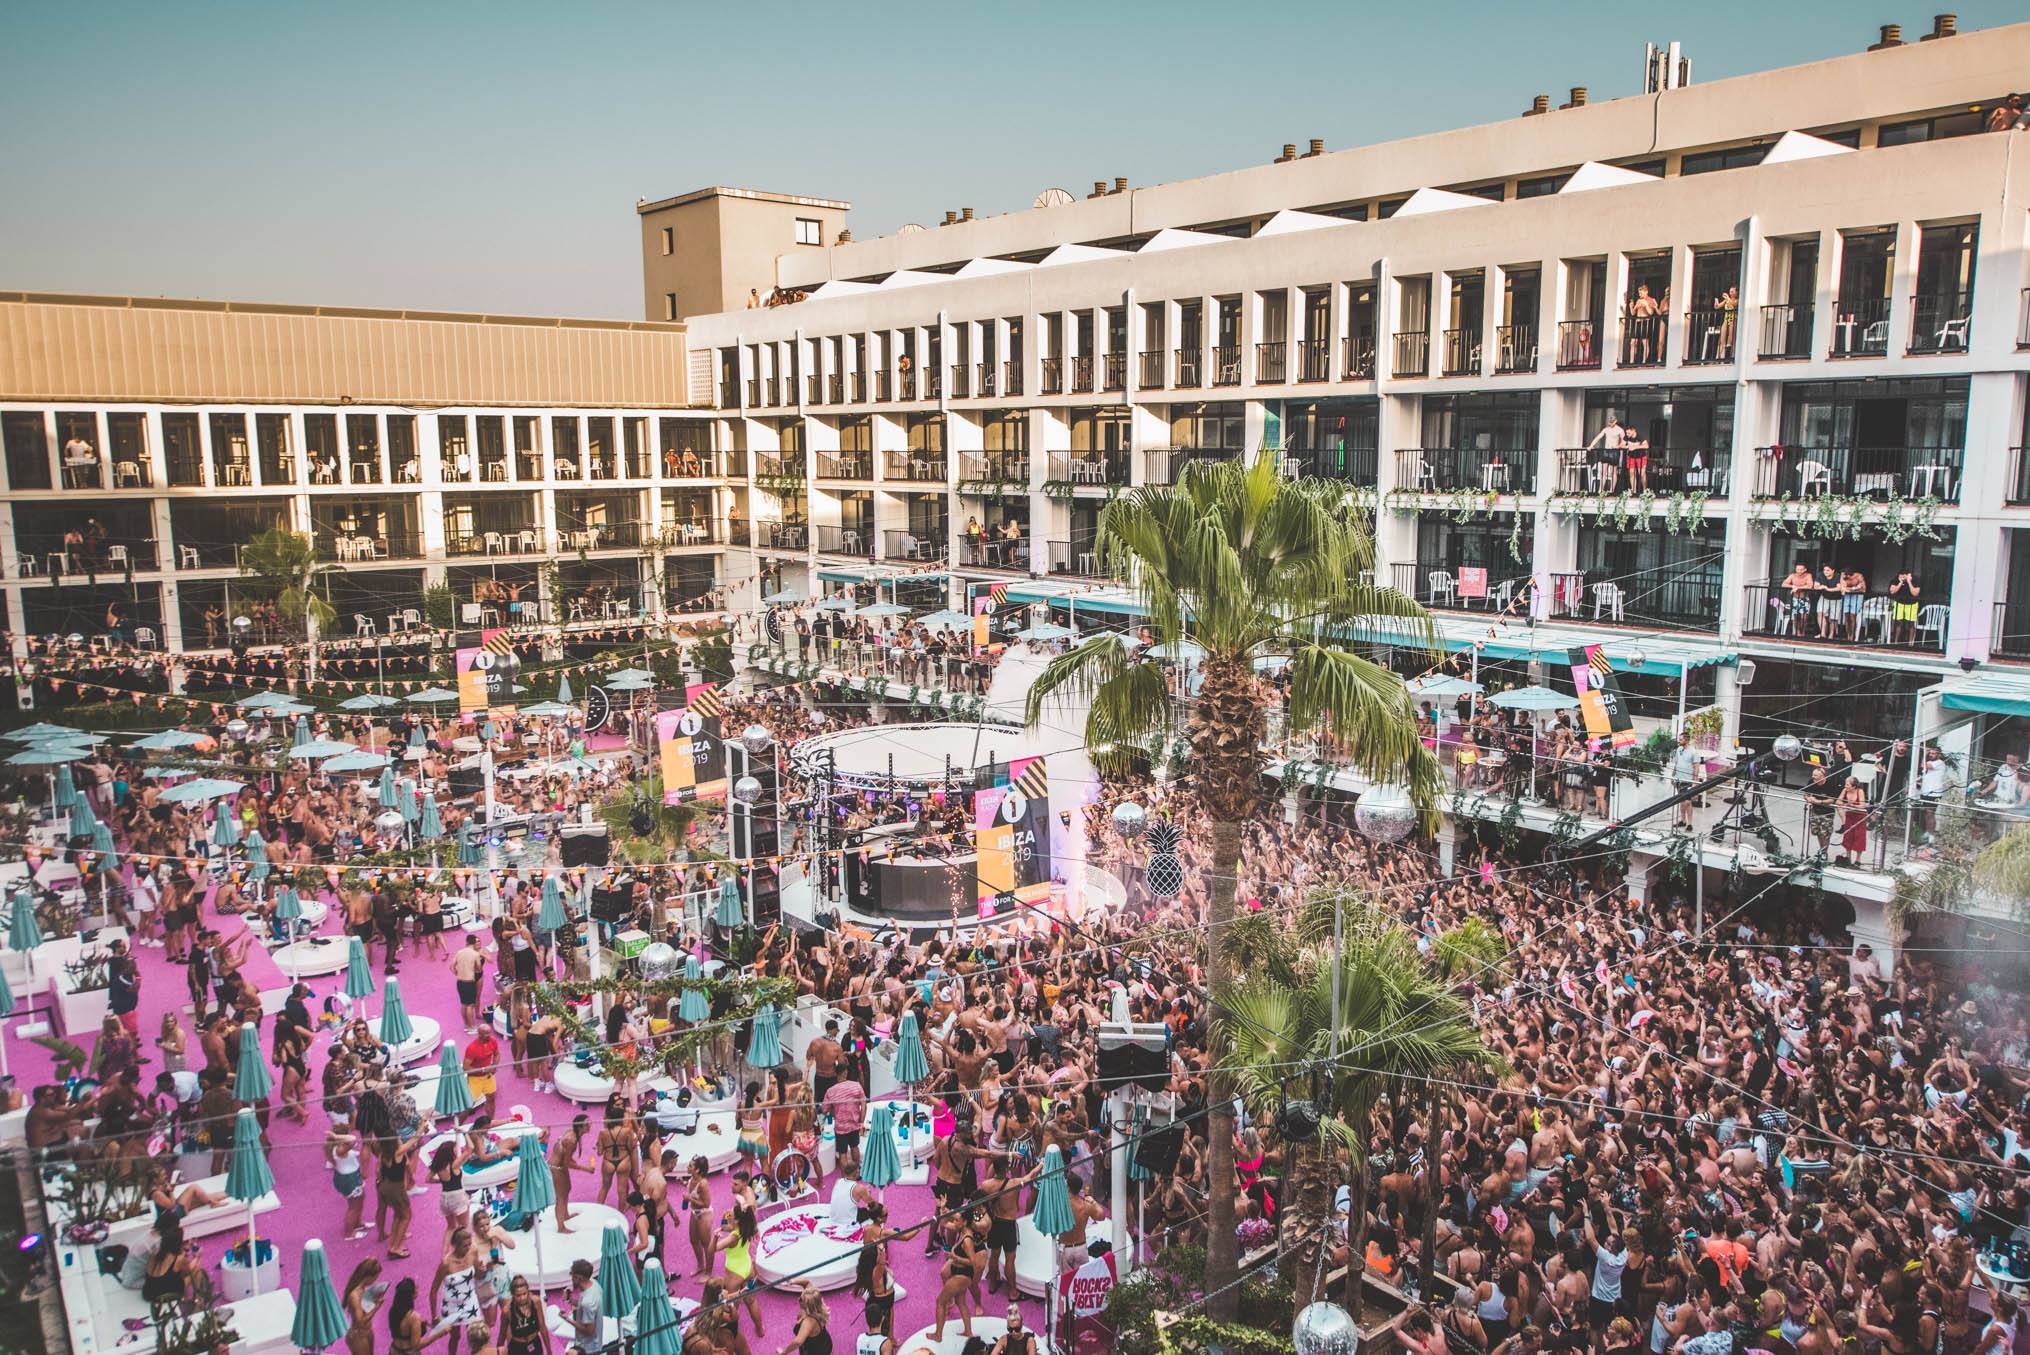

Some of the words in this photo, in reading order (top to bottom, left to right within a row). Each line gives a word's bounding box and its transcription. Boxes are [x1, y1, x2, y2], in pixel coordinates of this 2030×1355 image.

[473, 673, 503, 685] IBIZA
[678, 739, 712, 757] IBIZA
[682, 752, 709, 769] 2019
[997, 829, 1037, 850] IBIZA
[1000, 847, 1033, 867] 2019
[1000, 896, 1011, 905] FOR
